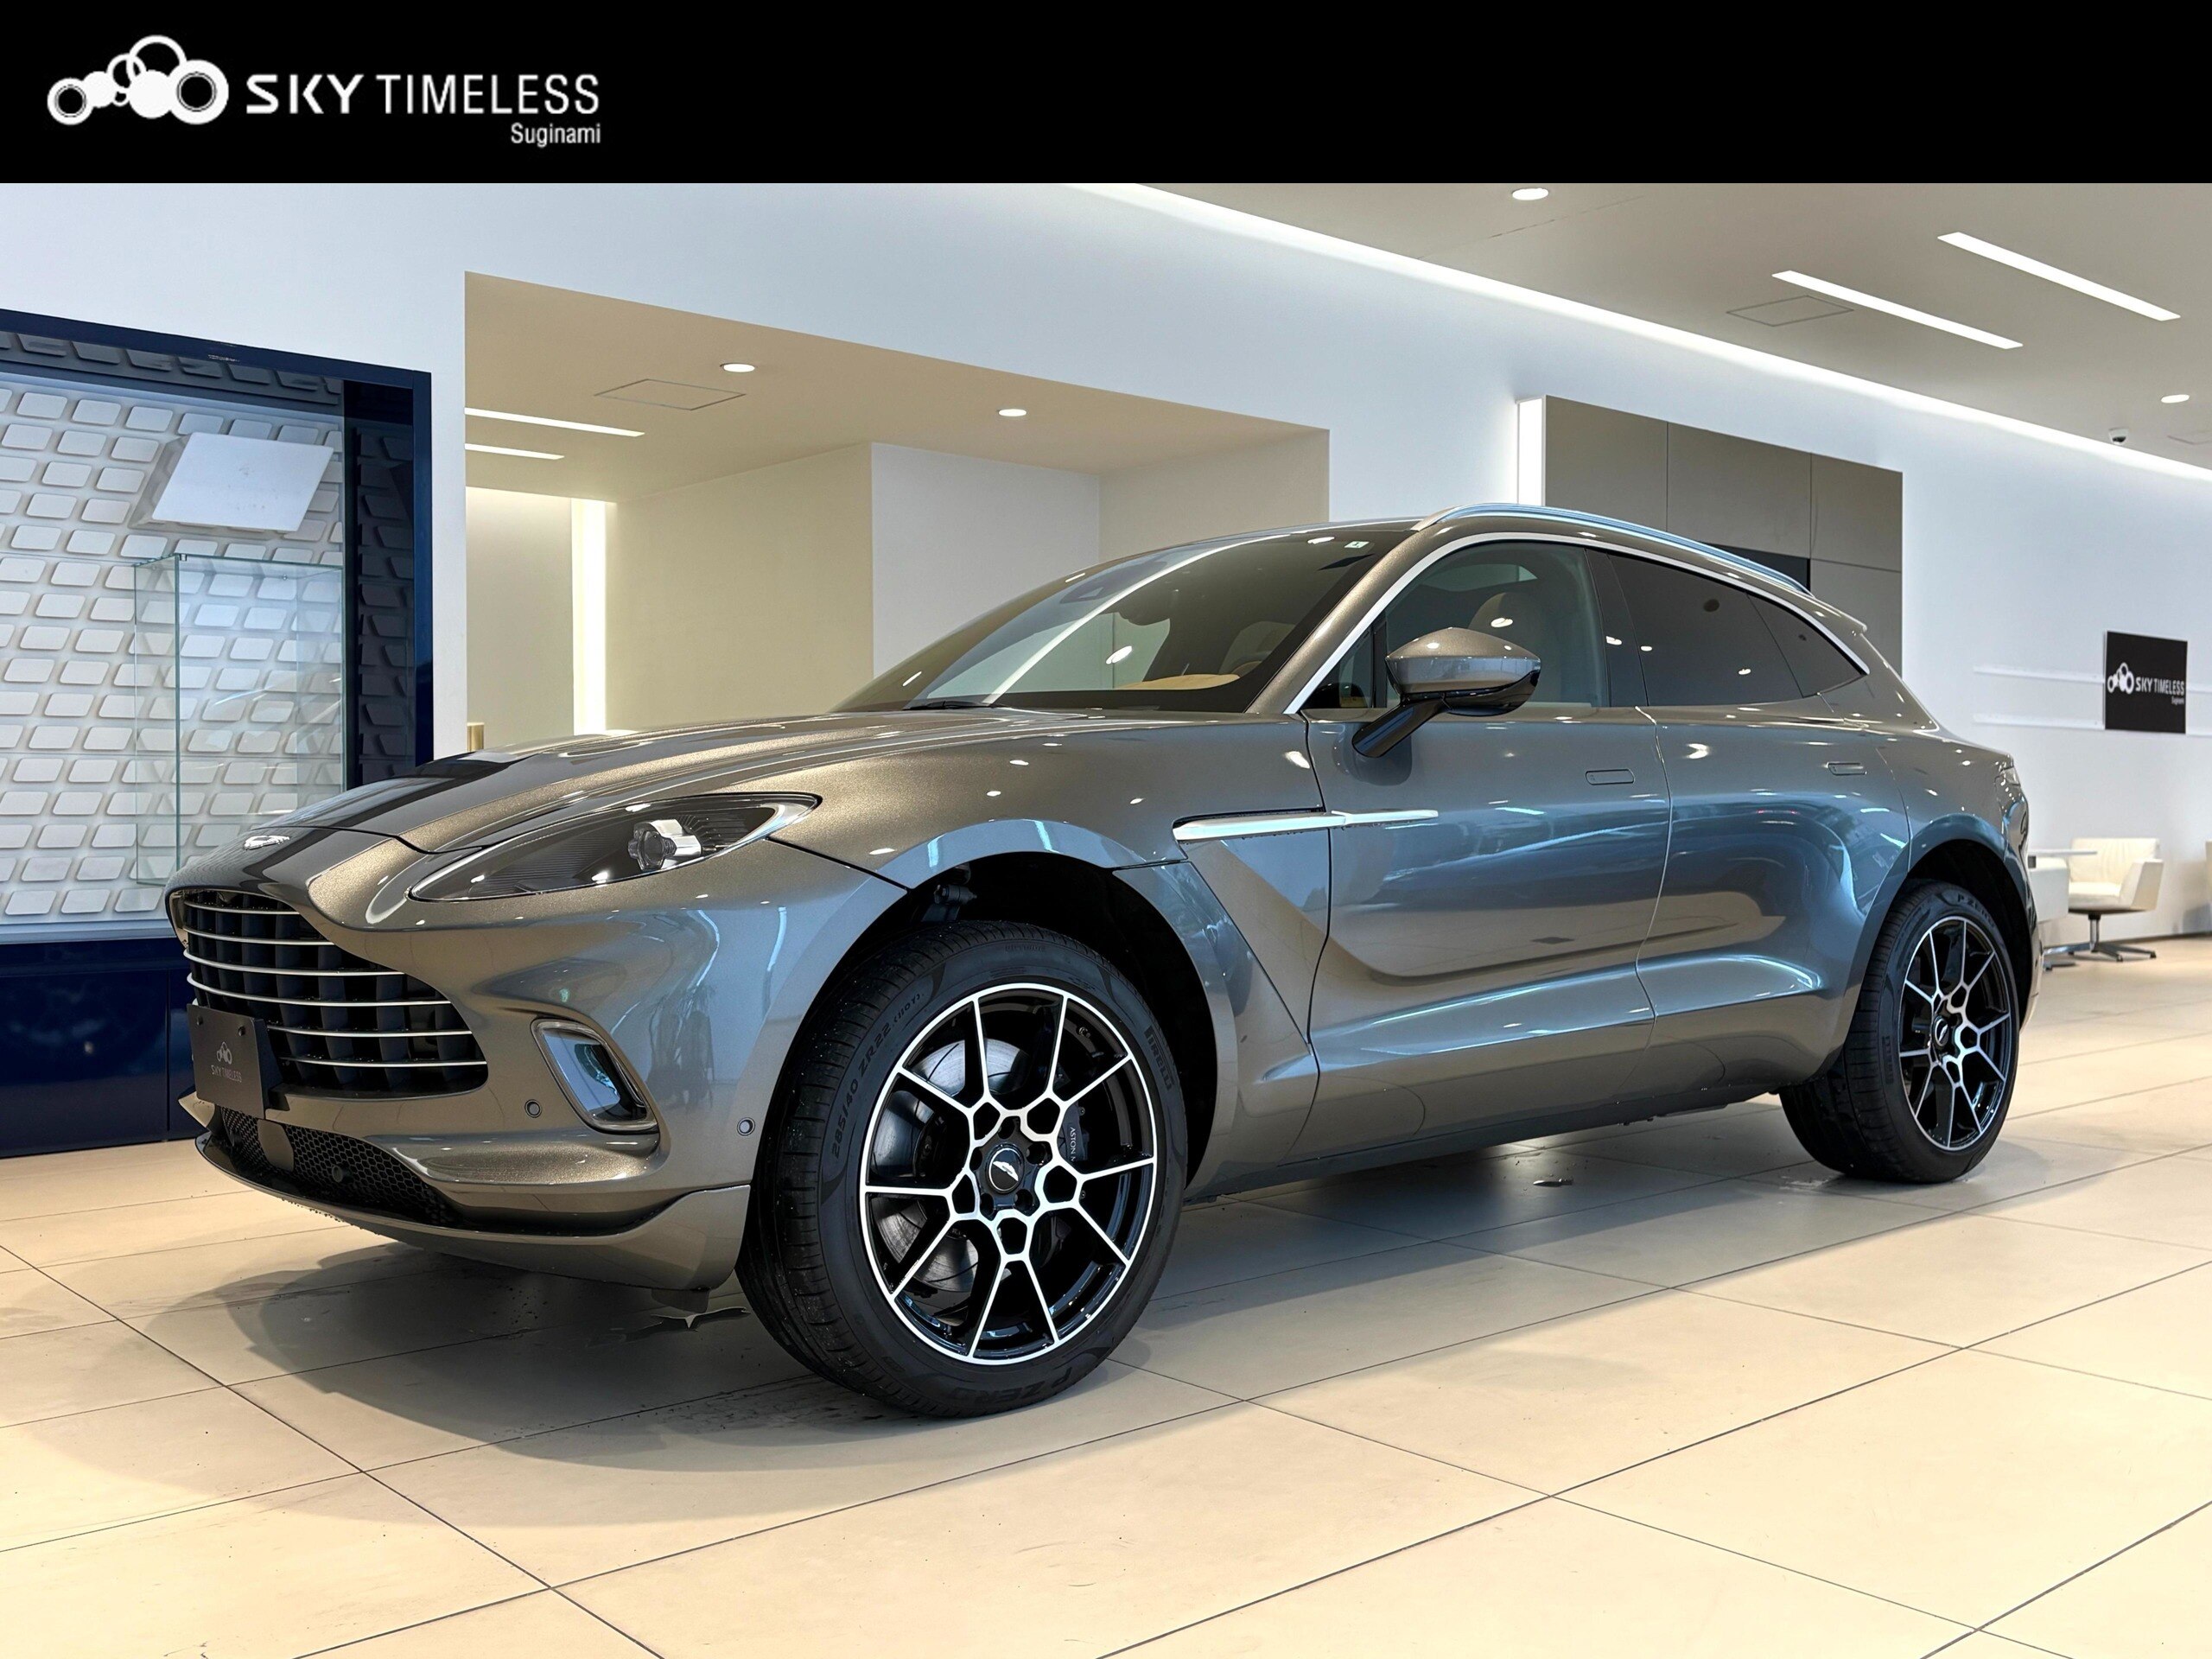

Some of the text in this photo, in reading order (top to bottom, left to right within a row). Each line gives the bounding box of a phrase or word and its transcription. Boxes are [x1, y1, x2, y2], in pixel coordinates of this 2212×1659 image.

[2135, 677, 2184, 696] SKY TIMELESS
[831, 1077, 859, 1160] 285/40
[858, 1022, 892, 1078] ZR22
